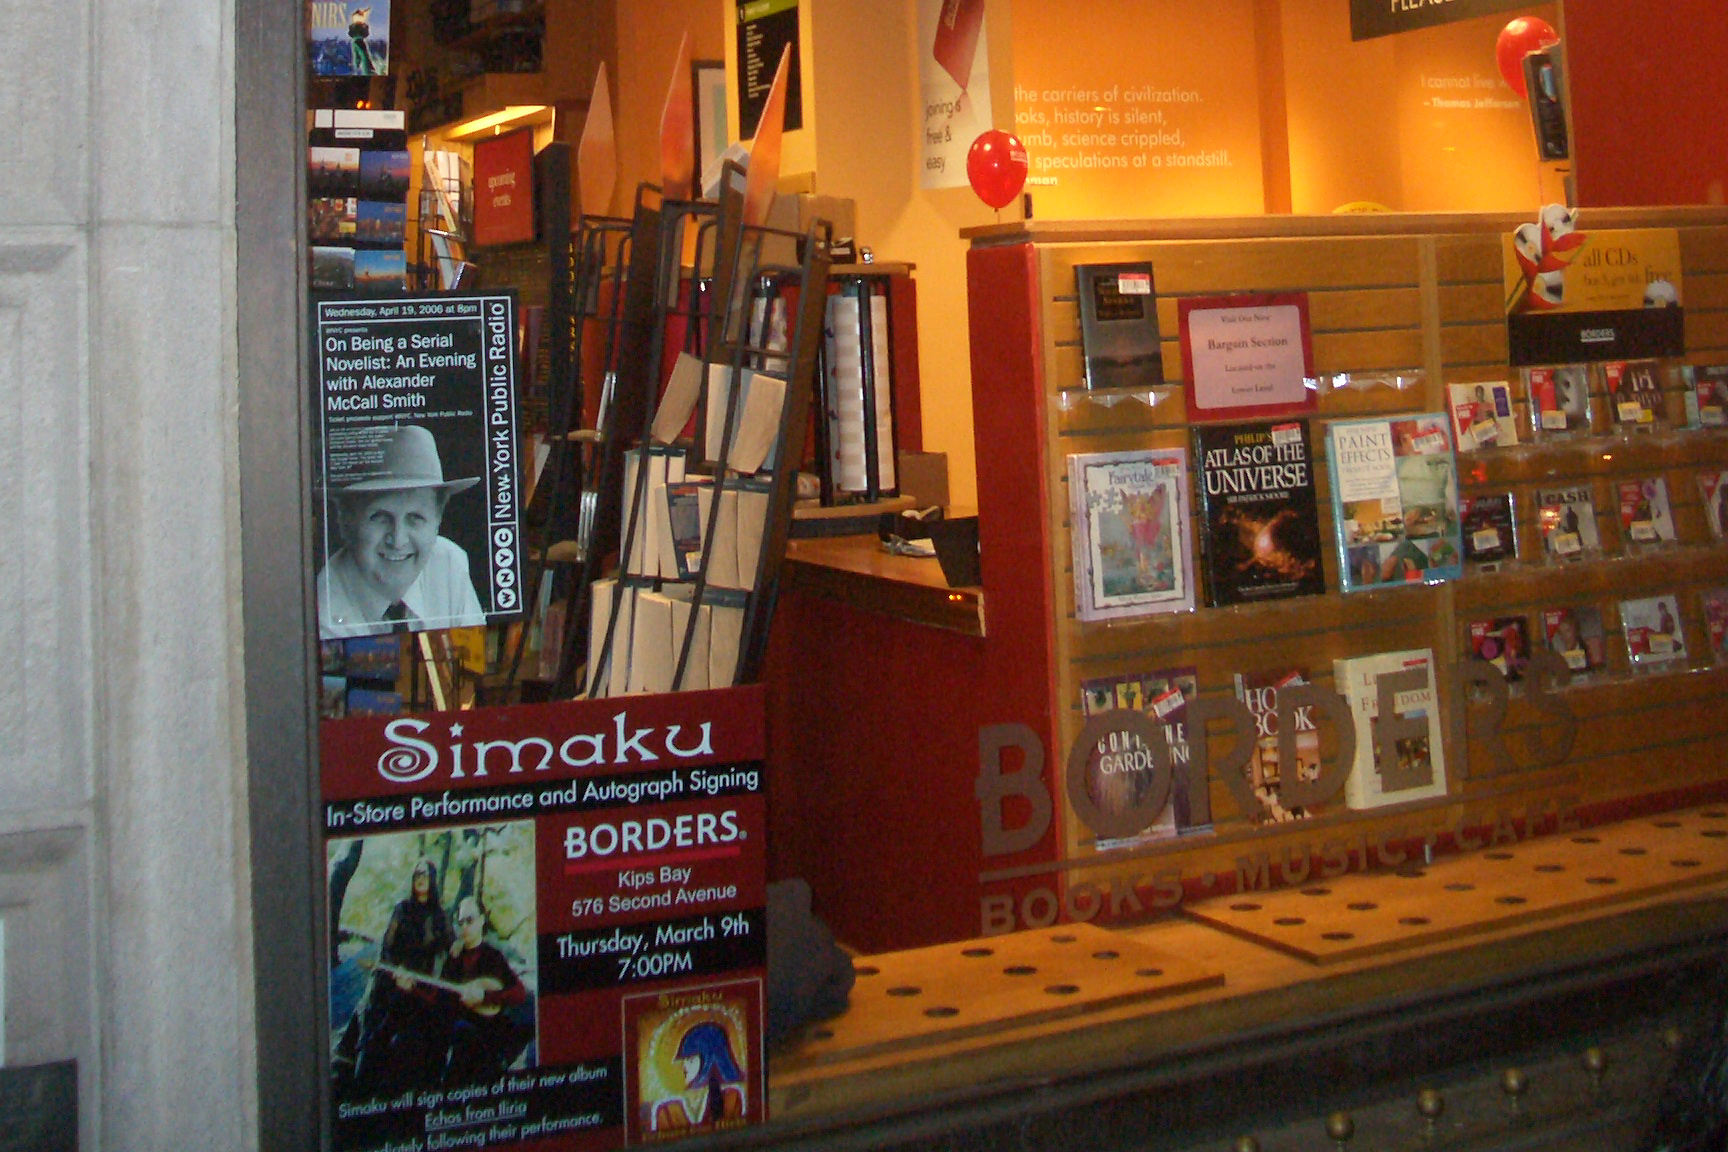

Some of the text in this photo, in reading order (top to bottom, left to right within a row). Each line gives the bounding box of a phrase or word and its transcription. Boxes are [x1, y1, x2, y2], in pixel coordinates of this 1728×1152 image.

[1427, 74, 1471, 89] cannot
[1014, 85, 1203, 102] the carriers of civilization.
[1432, 97, 1471, 108] Thomas
[1473, 97, 1521, 109] Jefferson
[925, 101, 953, 122] joining
[1054, 108, 1104, 128] history
[1108, 108, 1121, 124] is
[1124, 108, 1168, 127] silent,
[926, 129, 952, 146] free &
[1062, 131, 1117, 147] science
[1120, 129, 1186, 149] crippled,
[926, 155, 946, 173] easy
[1035, 151, 1129, 171] speculations
[1132, 152, 1148, 168] at
[1152, 155, 1162, 168] a
[1165, 150, 1233, 168] standstill.
[1583, 247, 1638, 267] all CDs
[325, 306, 378, 319] Wednesday,
[379, 305, 399, 317] April
[402, 305, 417, 316] 19,
[445, 305, 455, 314] at
[325, 333, 454, 353] On Being a Serial
[1208, 336, 1288, 352] Bargain Section
[326, 352, 477, 372] Novelist: An Evening
[326, 373, 436, 392] with Alexander
[327, 393, 426, 411] McCall Smith
[1339, 433, 1387, 450] PAINT
[488, 302, 517, 610] WNYC New York Public Radio
[1205, 442, 1306, 469] ATLAS OF THE
[1341, 448, 1391, 464] EFFECTS
[1205, 462, 1309, 496] UNIVERSE
[1545, 491, 1589, 504] CASH
[376, 711, 715, 783] Simaku
[974, 647, 1578, 856] BORDERS
[326, 767, 759, 827] In-Store Performance and Autograph Signing
[563, 810, 740, 859] BORDERS
[618, 866, 692, 889] Kips Bay
[980, 868, 1185, 938] BOOKS
[1235, 830, 1408, 893] MUSIC
[572, 884, 737, 917] 576 Second Avenue
[556, 913, 749, 960] Thursday, March 9th
[617, 952, 693, 982] 7:00PM
[338, 1064, 608, 1119] Simaku will sign copies of their new album
[465, 1105, 495, 1123] from
[427, 1127, 487, 1151] following
[489, 1123, 519, 1142] their
